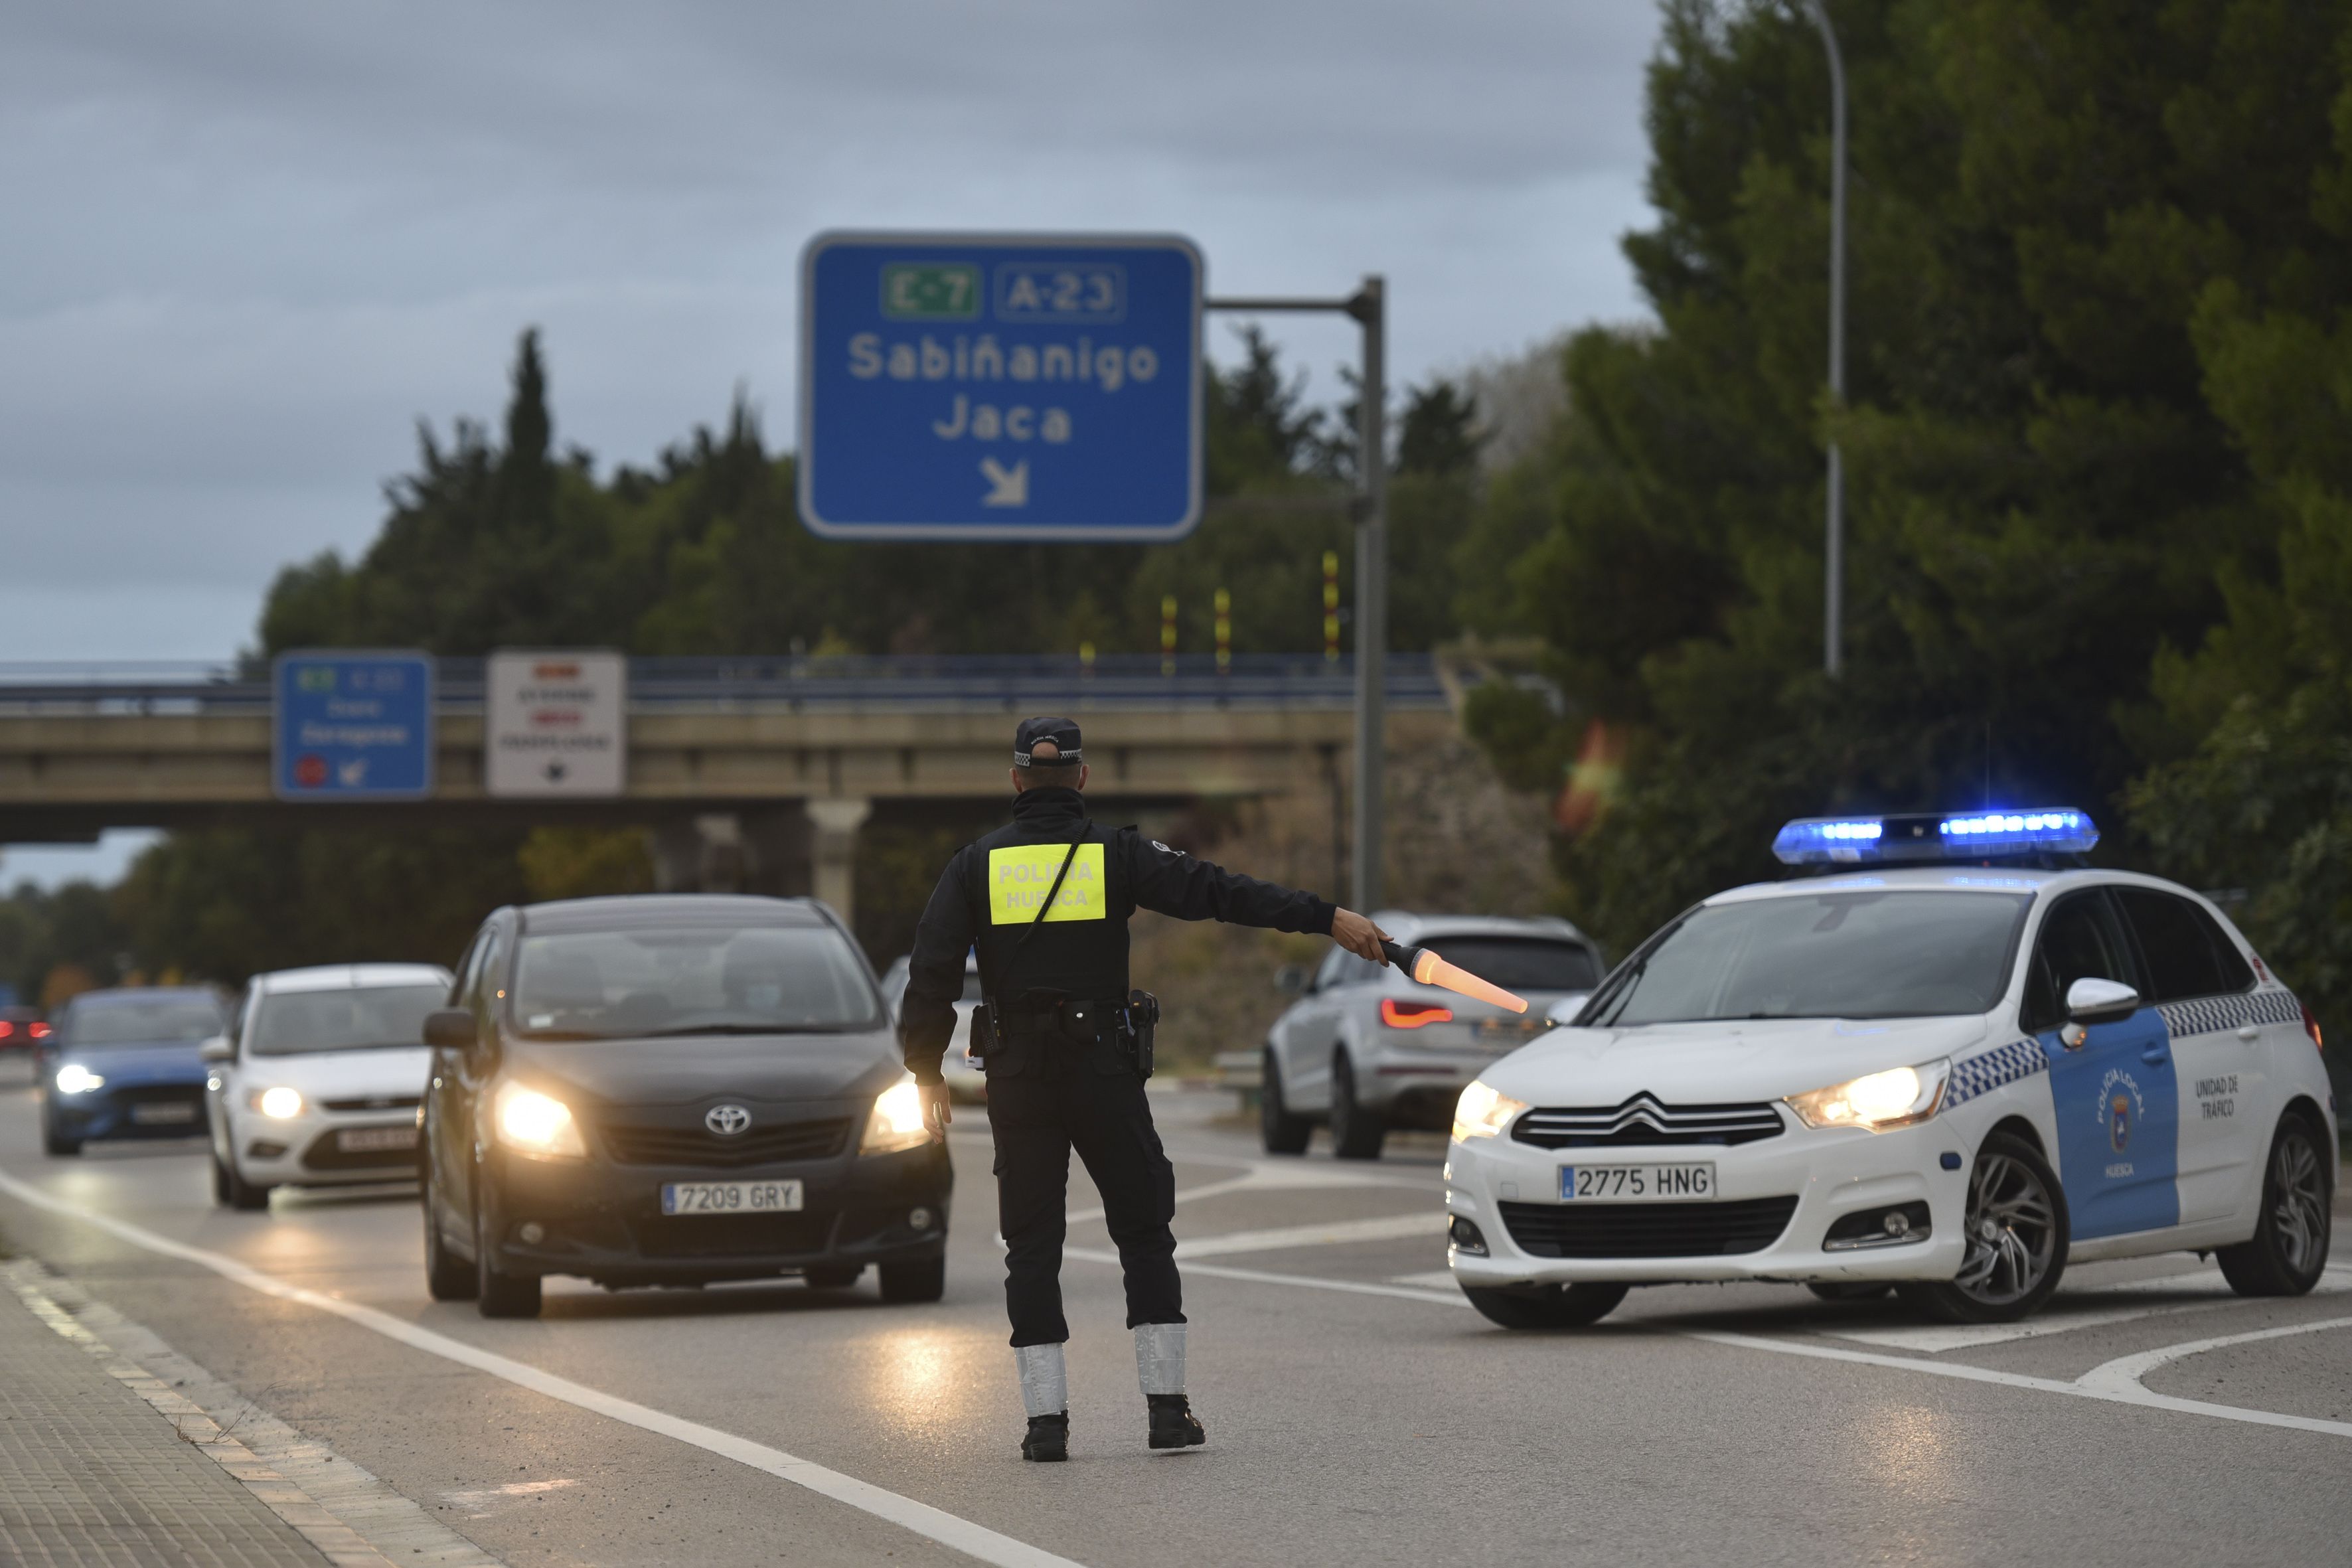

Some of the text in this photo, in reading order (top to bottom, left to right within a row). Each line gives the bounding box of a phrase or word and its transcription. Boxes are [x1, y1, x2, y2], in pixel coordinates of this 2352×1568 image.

[1008, 272, 1115, 311] A-23
[931, 392, 1073, 444] Jaca
[2118, 1068, 2146, 1123] LOCAL
[2195, 1074, 2238, 1098] UNIDAD DE
[1577, 1167, 1709, 1196] 2775 HNG
[2105, 1162, 2134, 1178] HUESCA
[681, 1183, 795, 1210] 7209 GRY
